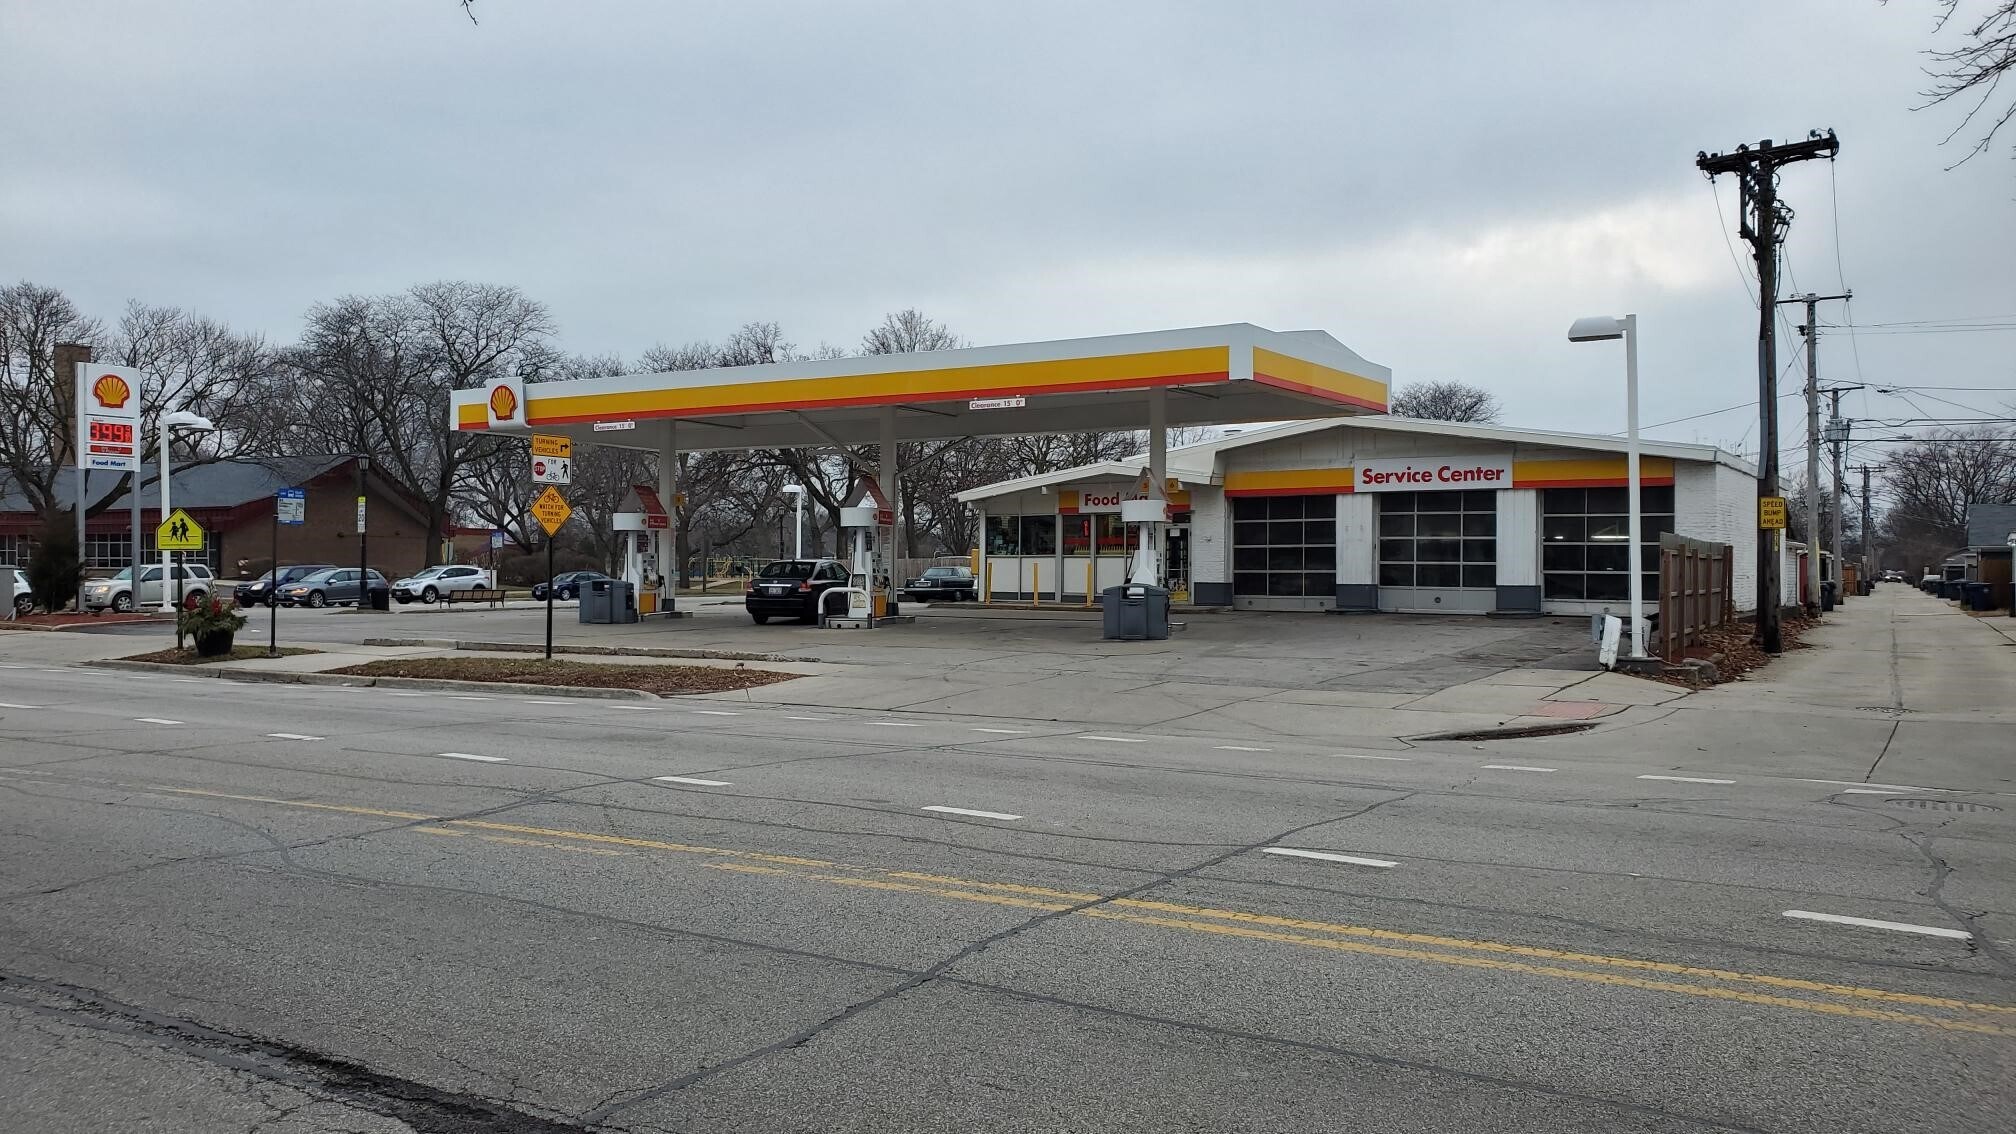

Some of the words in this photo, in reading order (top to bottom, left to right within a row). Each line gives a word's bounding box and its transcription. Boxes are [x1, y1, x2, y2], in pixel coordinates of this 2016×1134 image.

[535, 437, 559, 446] TURNING
[534, 446, 559, 455] VEHICLES
[1362, 466, 1433, 485] Service
[1437, 465, 1505, 483] Center
[1084, 491, 1120, 506] Food
